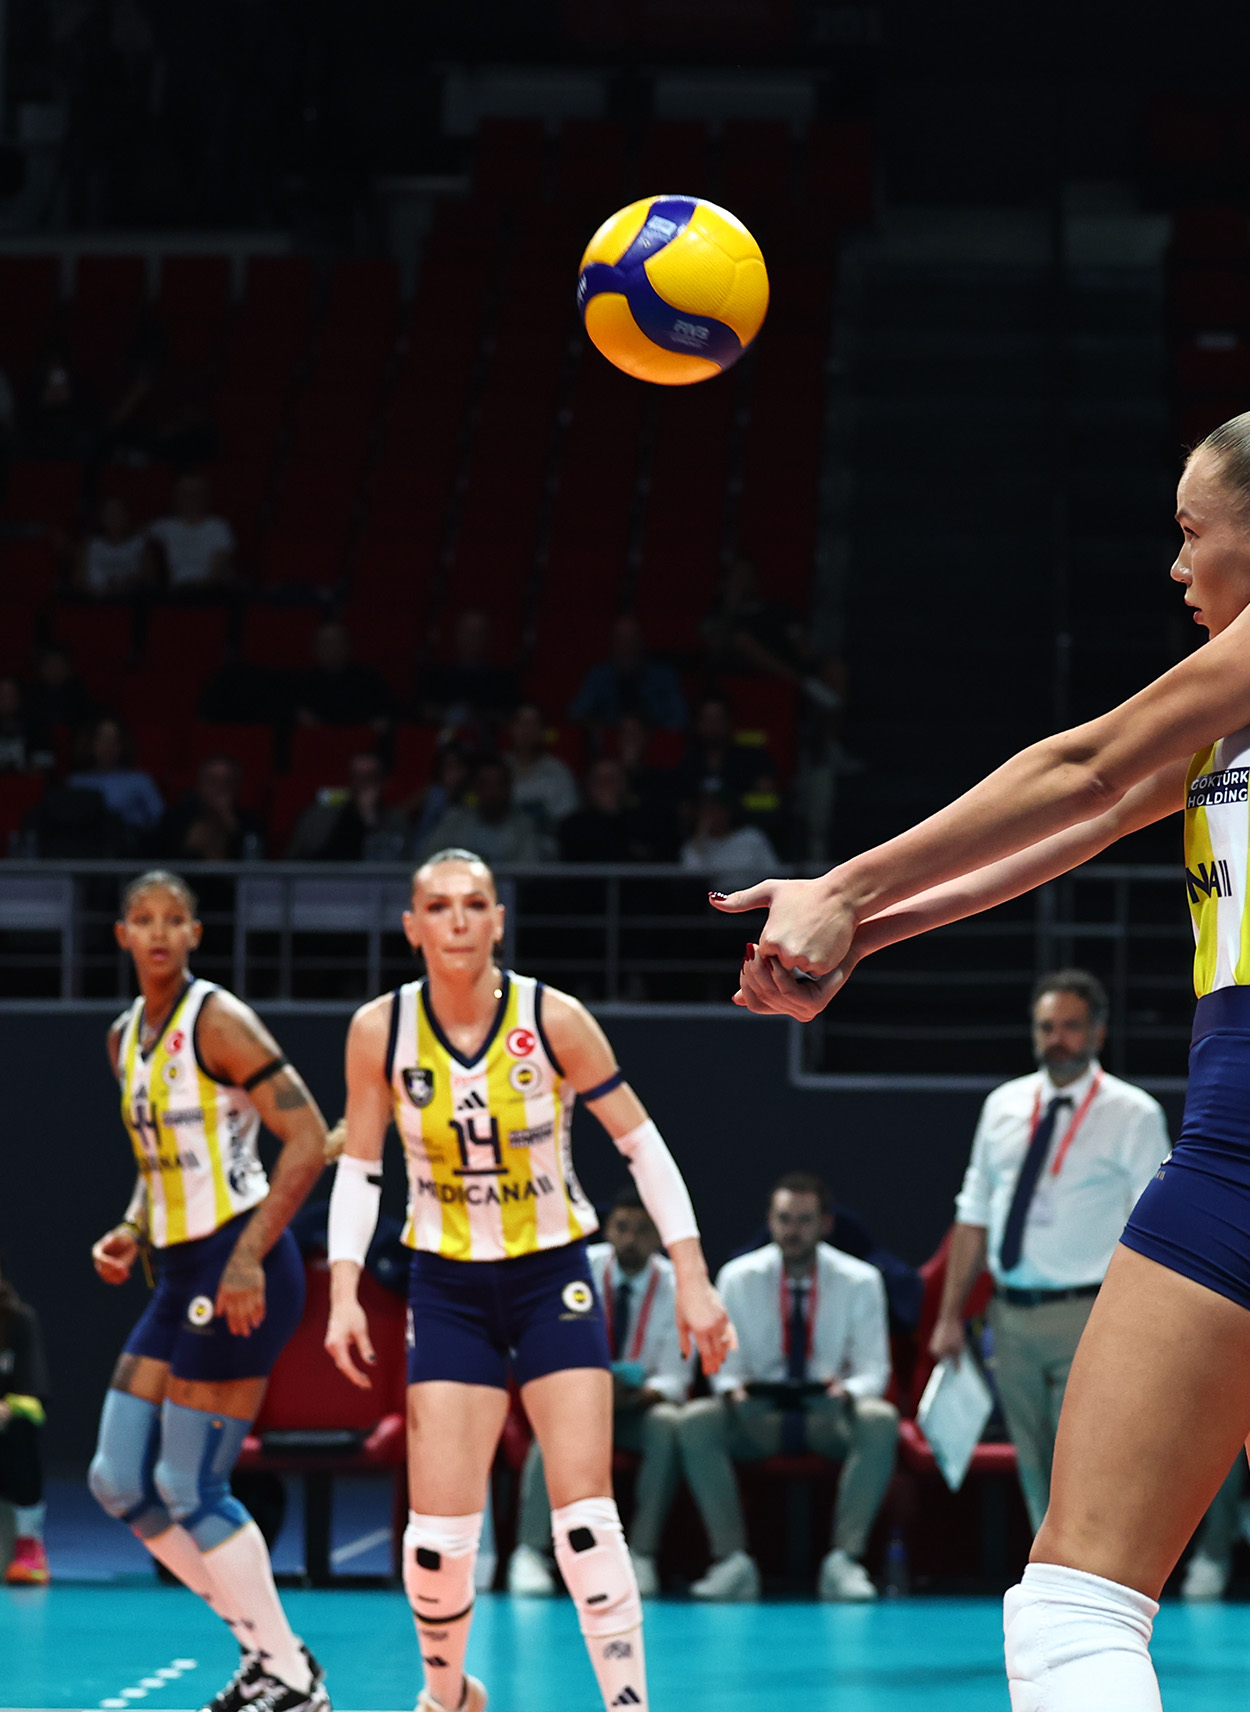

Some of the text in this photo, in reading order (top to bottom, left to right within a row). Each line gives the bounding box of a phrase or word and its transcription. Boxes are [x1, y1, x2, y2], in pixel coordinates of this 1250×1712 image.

[1190, 770, 1249, 790] GÖKTÜRK
[1187, 787, 1248, 808] HOLDİNG
[449, 1116, 503, 1167] 14
